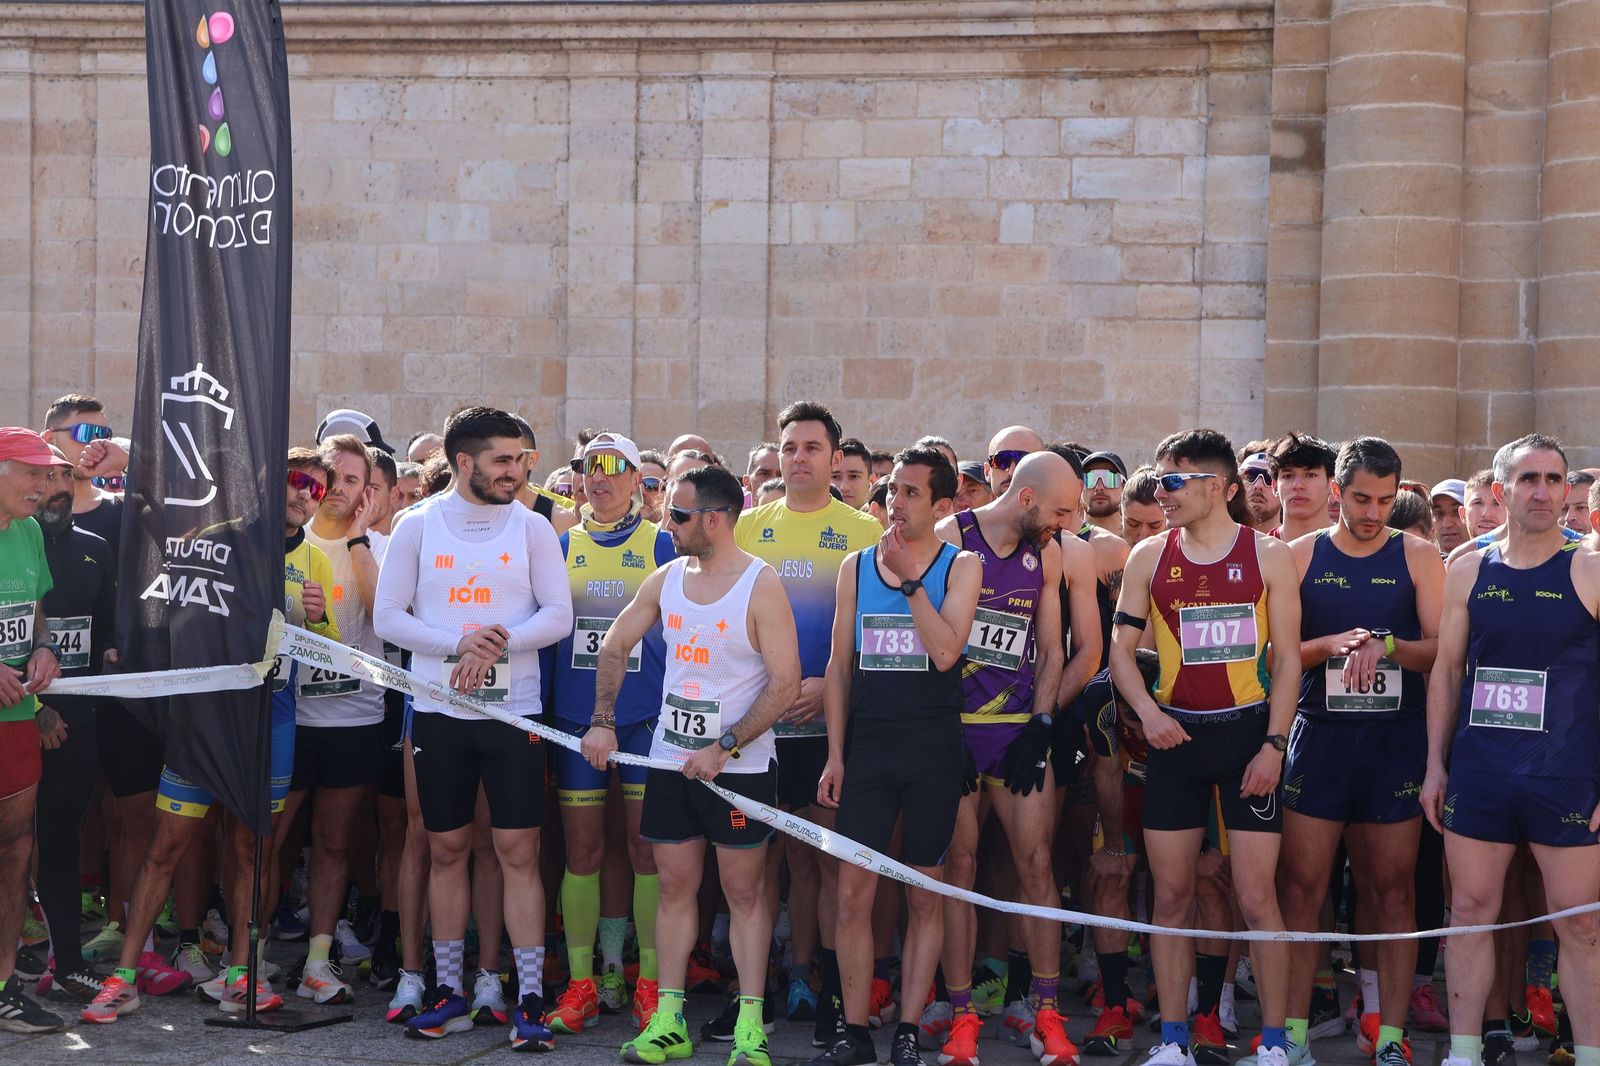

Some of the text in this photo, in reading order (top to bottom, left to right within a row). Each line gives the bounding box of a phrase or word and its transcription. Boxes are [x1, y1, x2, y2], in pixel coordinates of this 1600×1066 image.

[819, 541, 847, 551] DUERO
[587, 580, 624, 598] PRIETO
[1008, 597, 1033, 608] PRIM
[873, 629, 914, 654] 733
[980, 624, 1018, 652] 147
[1195, 620, 1241, 646] 707
[289, 644, 333, 665] ZAMORA
[369, 670, 412, 691] ZAMORA
[1484, 684, 1528, 711] 763
[671, 709, 707, 736] 173
